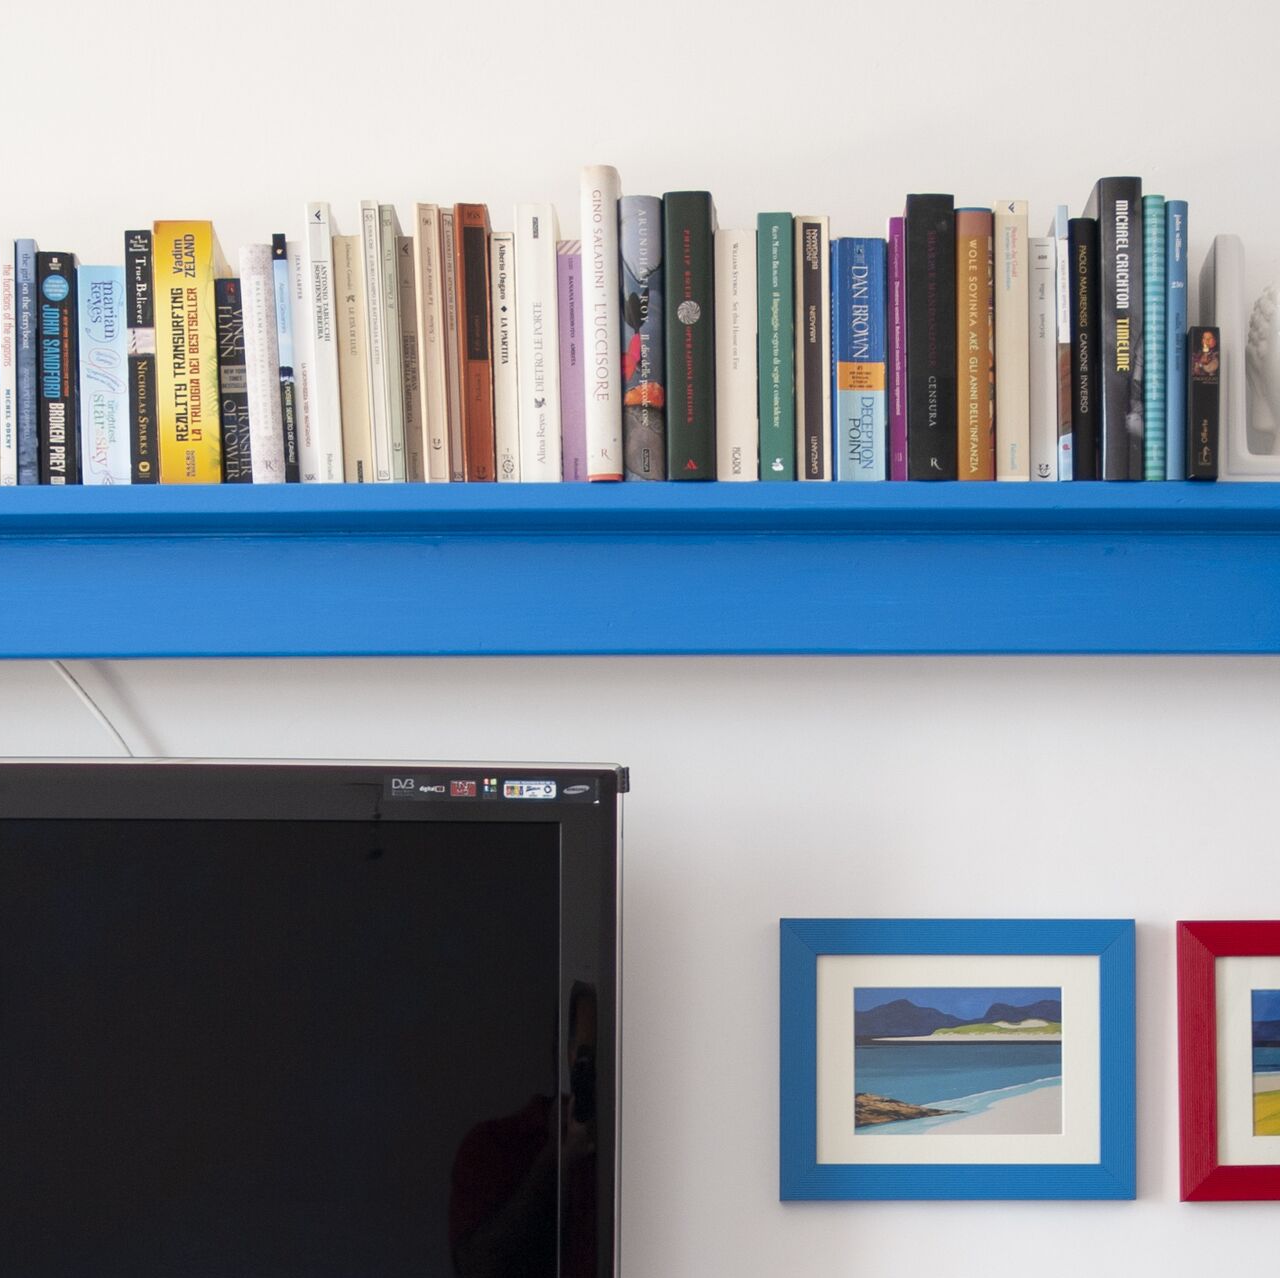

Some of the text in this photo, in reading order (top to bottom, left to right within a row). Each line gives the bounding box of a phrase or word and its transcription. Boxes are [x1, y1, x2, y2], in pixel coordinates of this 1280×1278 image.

[3, 264, 13, 277] the
[173, 239, 183, 275] Vadim
[184, 234, 196, 278] ZELAND
[638, 209, 649, 289] ARUNDHATI
[811, 228, 819, 270] BERGMAN
[3, 279, 14, 311] functions
[88, 281, 102, 323] keyes
[135, 256, 146, 324] True Believer
[315, 264, 324, 340] SOSTIENE PEREIRA
[322, 265, 330, 300] ANTONIO
[498, 272, 506, 300] Ongaro
[592, 189, 609, 402] GINO SALADINI L'UCCISORE
[851, 266, 870, 298] DAN
[1115, 200, 1130, 372] MICHAEL CRICHTON TIMELINE
[3, 323, 14, 334] the
[4, 313, 15, 321] of
[102, 281, 115, 339] marian
[500, 317, 508, 328] LA
[640, 295, 649, 322] ROY
[1078, 245, 1089, 413] PAOLO MAURENSIG CANONE INVERSO
[1, 336, 13, 367] orgasms
[42, 304, 60, 398] JOHN SANDFORD
[218, 306, 233, 357] FLYNN
[501, 330, 509, 365] PARTITA
[641, 344, 649, 358] dio
[851, 304, 870, 358] BROWN
[170, 288, 188, 441] REALITY TRANSURFING
[187, 287, 203, 441] LA TRILOGIA DEI BESTSELLER
[533, 302, 546, 464] Alina Reyes DIETRO LE PORTE
[641, 359, 650, 378] delle
[136, 360, 150, 455] NICHOLAS SPARKS
[223, 400, 236, 422] OF
[639, 380, 650, 407] piccole
[48, 402, 65, 472] BROKEN PREY
[107, 400, 118, 443] brightest
[642, 409, 650, 426] cose
[861, 396, 875, 470] DECEPTION
[225, 426, 240, 479] POWER
[237, 406, 251, 476] TRANSFER
[732, 447, 741, 475] PICADOR
[848, 417, 862, 464] POINT
